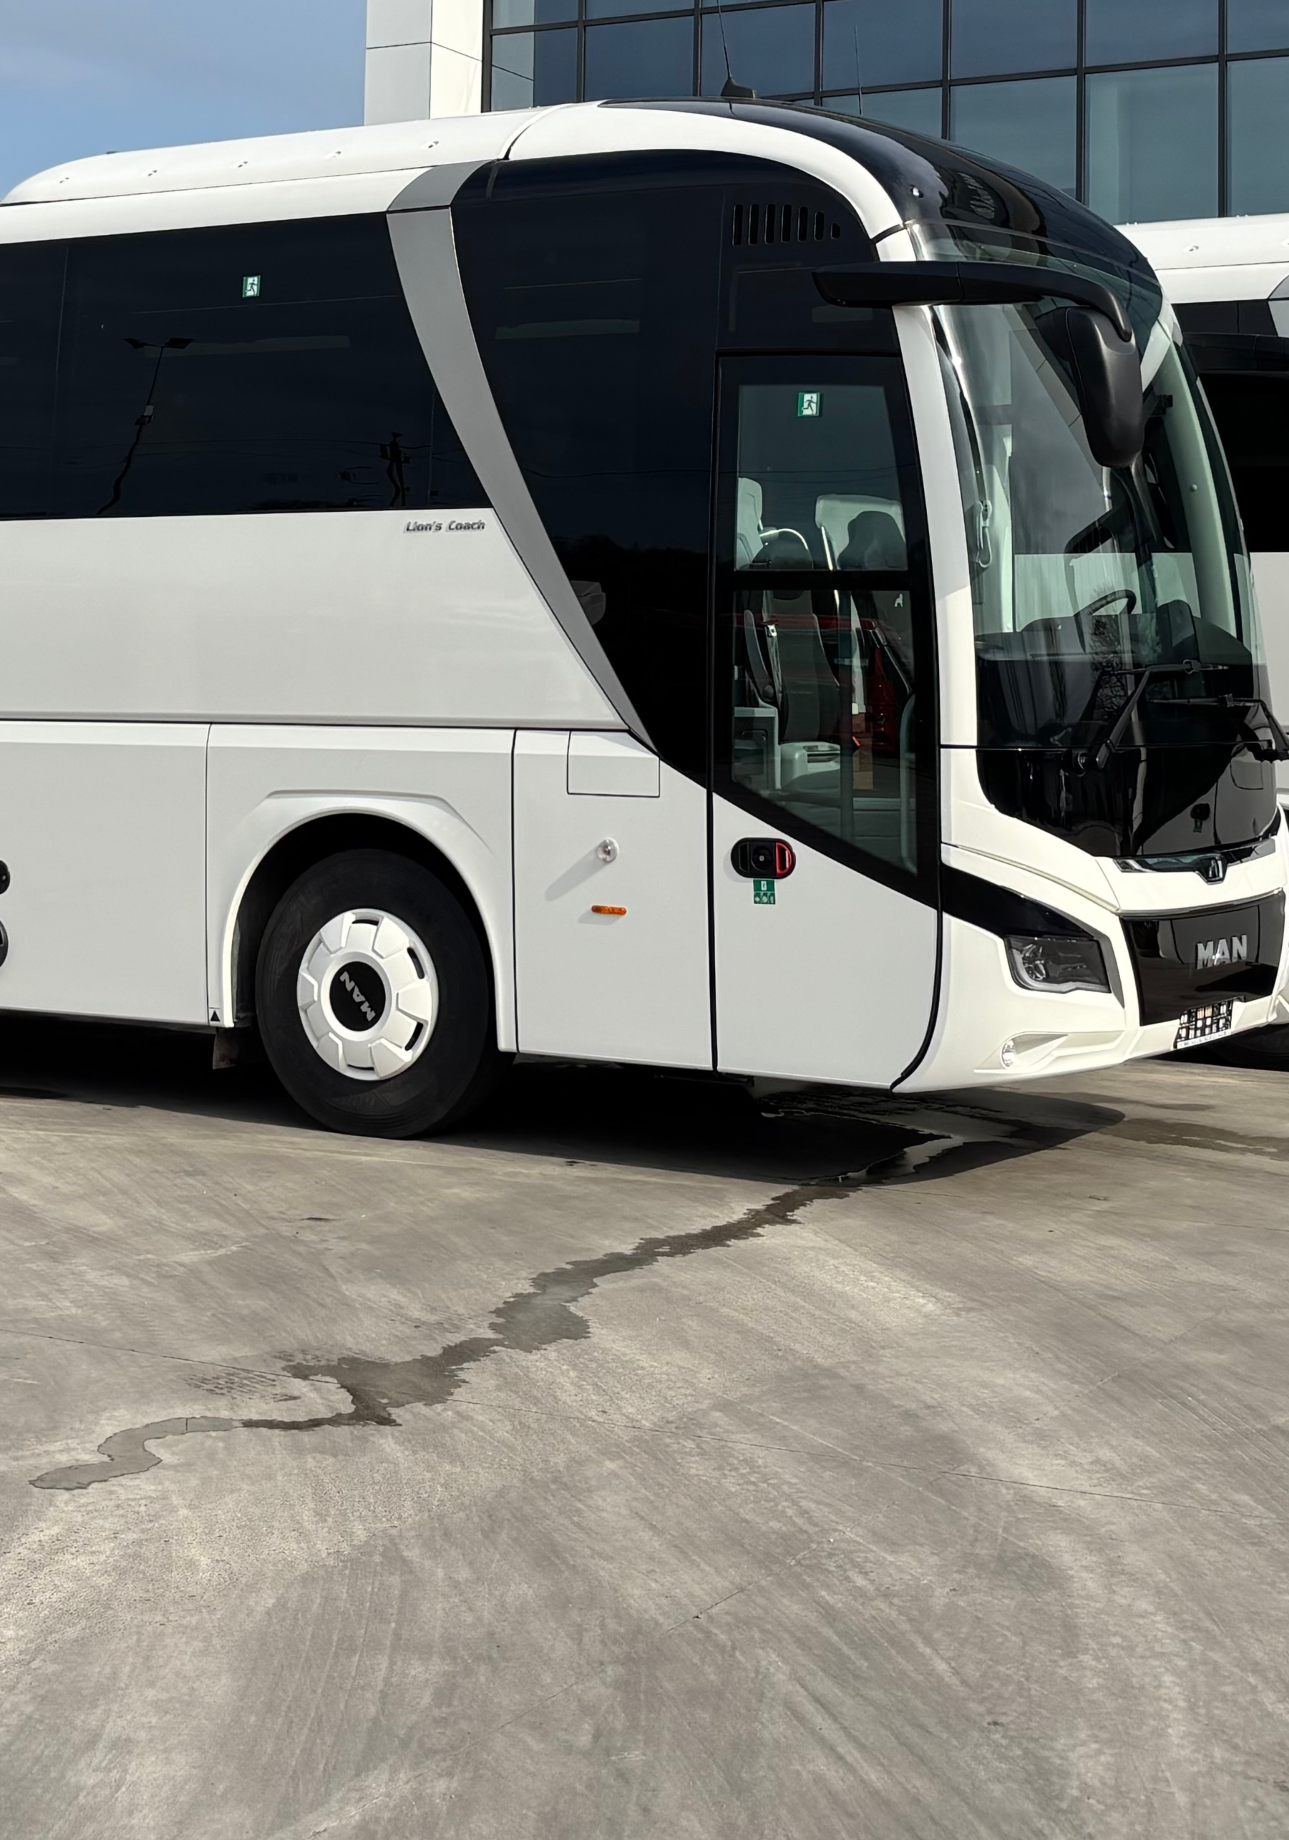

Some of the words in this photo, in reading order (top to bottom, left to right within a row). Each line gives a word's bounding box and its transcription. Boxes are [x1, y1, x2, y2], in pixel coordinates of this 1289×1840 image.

[405, 521, 443, 532] Lion's
[448, 520, 486, 531] Coach
[1196, 934, 1247, 969] MAN
[339, 970, 376, 1022] MAN
